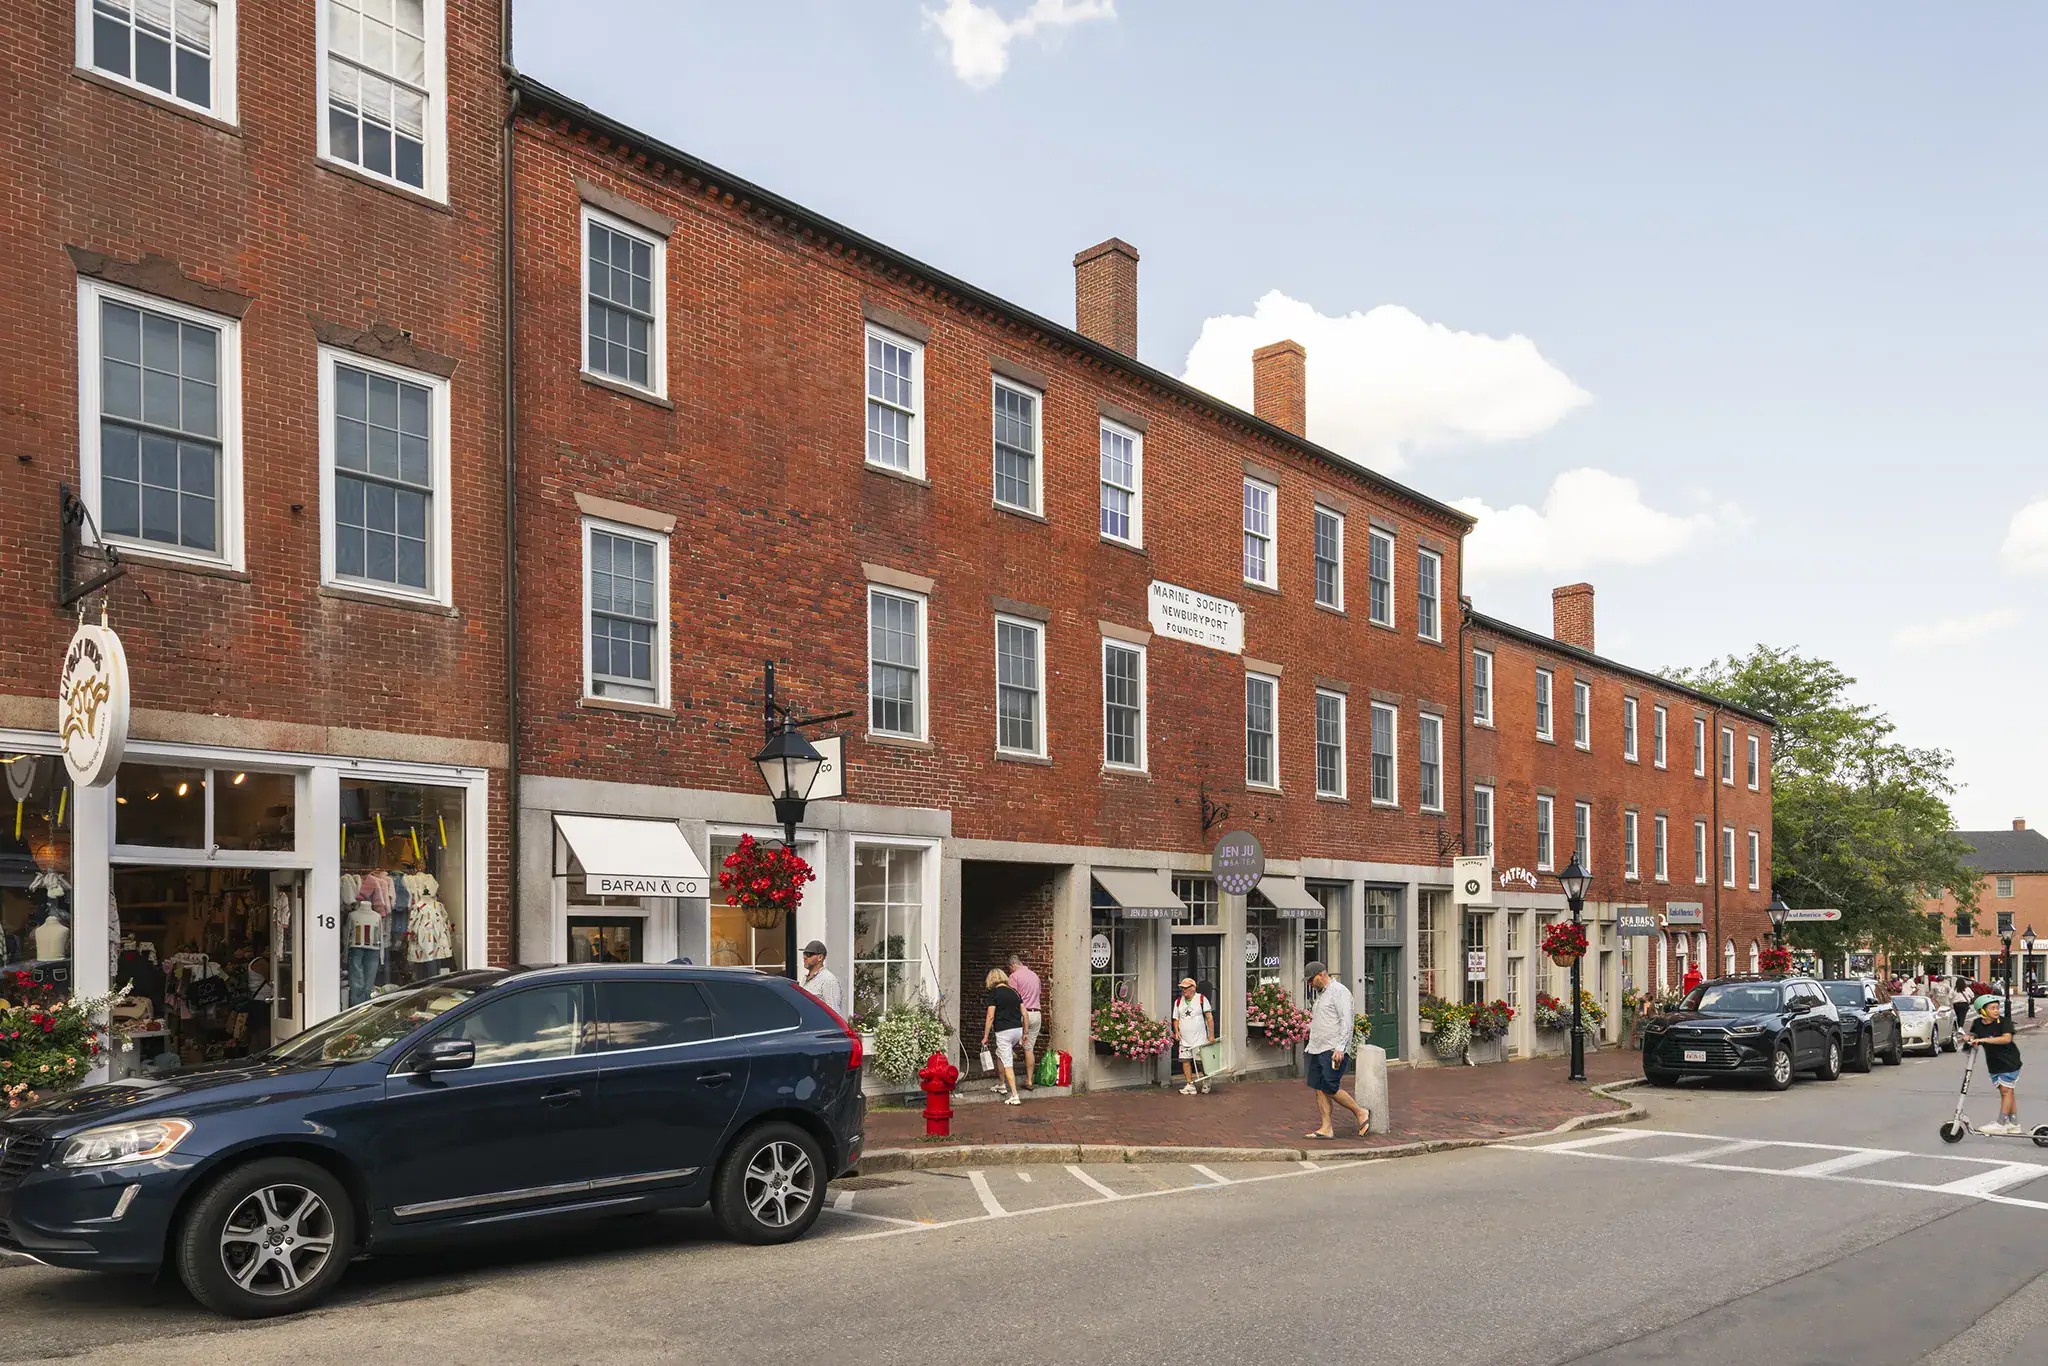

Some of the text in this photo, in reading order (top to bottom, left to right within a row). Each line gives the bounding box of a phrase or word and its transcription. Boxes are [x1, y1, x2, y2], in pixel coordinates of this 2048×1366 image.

[1153, 585, 1236, 617] MARINE SOCIETY
[1162, 605, 1228, 631] NEWBURYPORT
[1166, 622, 1205, 640] FOUNDED
[84, 638, 103, 672] KIDS
[821, 764, 832, 773] CO
[1220, 845, 1254, 858] JEN JU
[1218, 859, 1239, 867] BOBA
[1500, 867, 1538, 889] FATFACE
[601, 879, 697, 893] BARAN & CO
[1149, 909, 1169, 917] BOBA
[1171, 909, 1183, 917] TEA
[317, 914, 335, 930] 18
[1620, 916, 1655, 927] SEA BAGS
